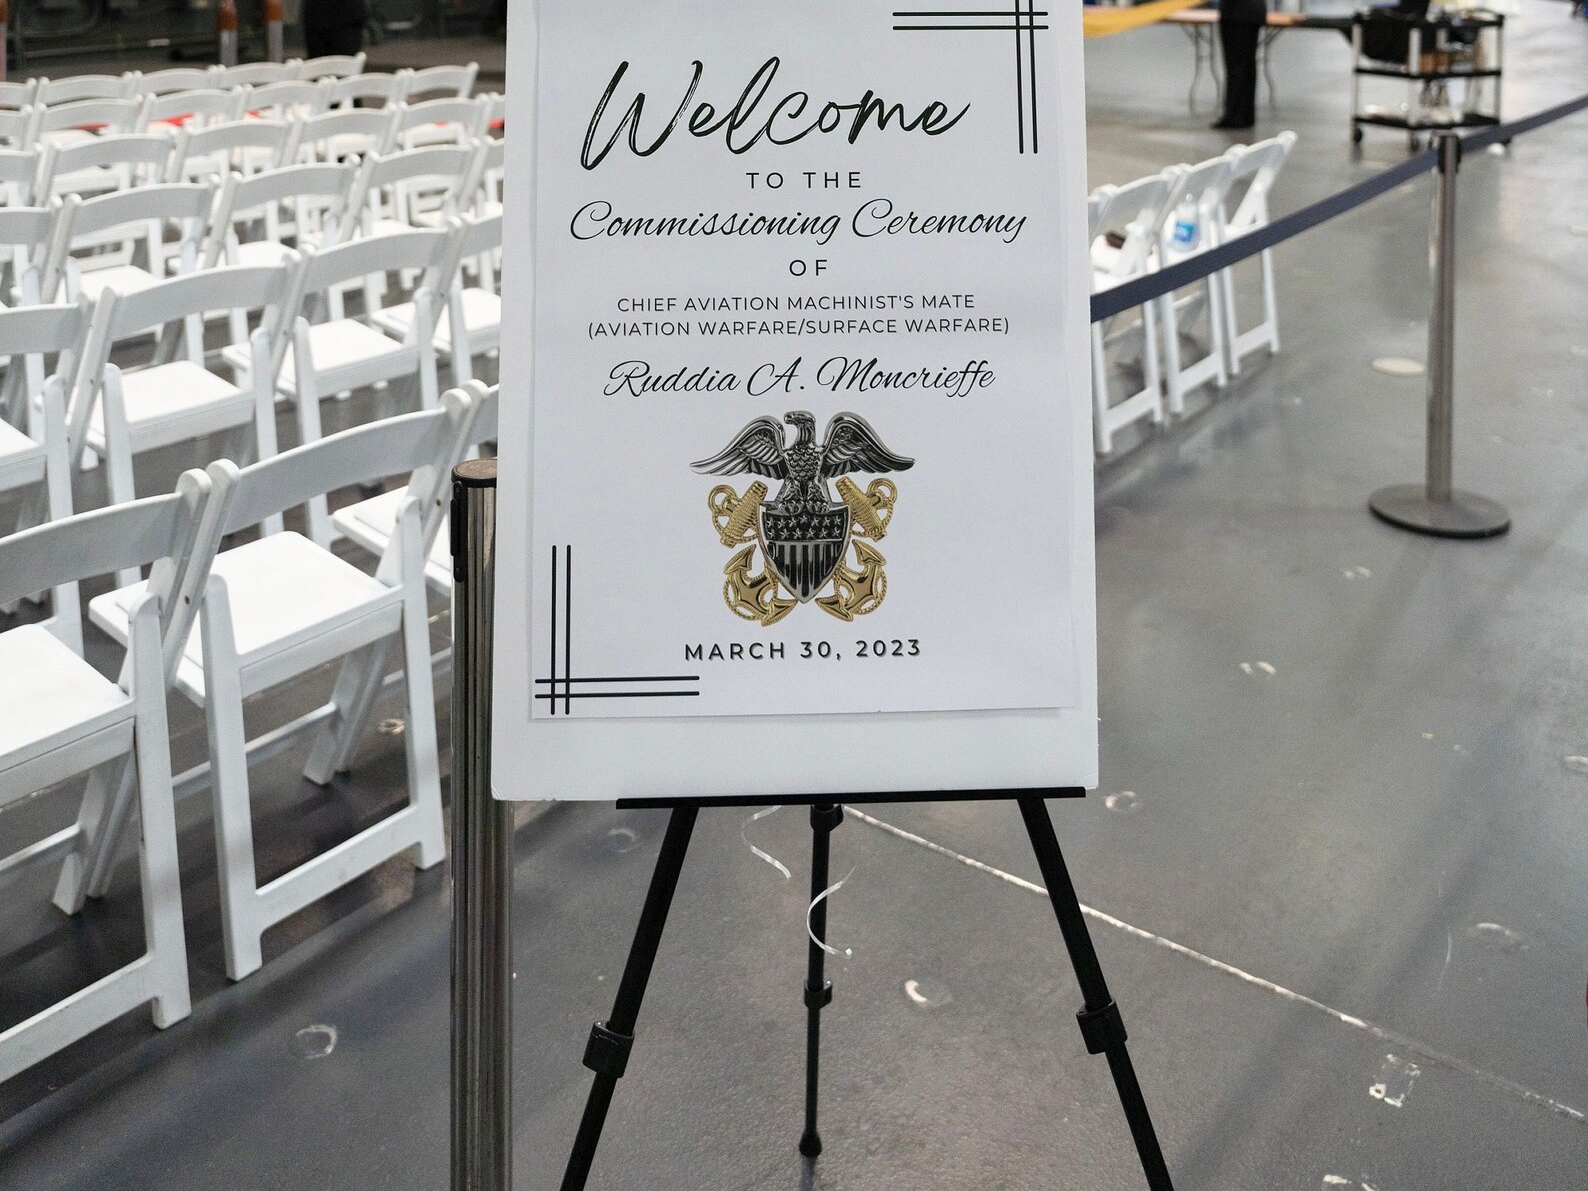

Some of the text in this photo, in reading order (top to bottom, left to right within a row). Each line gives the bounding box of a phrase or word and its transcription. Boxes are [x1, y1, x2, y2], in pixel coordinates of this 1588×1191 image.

[579, 55, 971, 171] Welcome
[745, 171, 862, 190] TO THE
[569, 198, 1028, 246] Commissioning Ceremony
[788, 258, 828, 277] OF
[617, 294, 975, 312] CHIEF AVIATION MACHINIST'S MATE
[588, 317, 1009, 340] (AVIATION WARFARE/SURFACE WARFARE)
[603, 355, 997, 398] Ruddia A. Moncrieffe
[684, 638, 921, 662] MARCH 30, 2023
